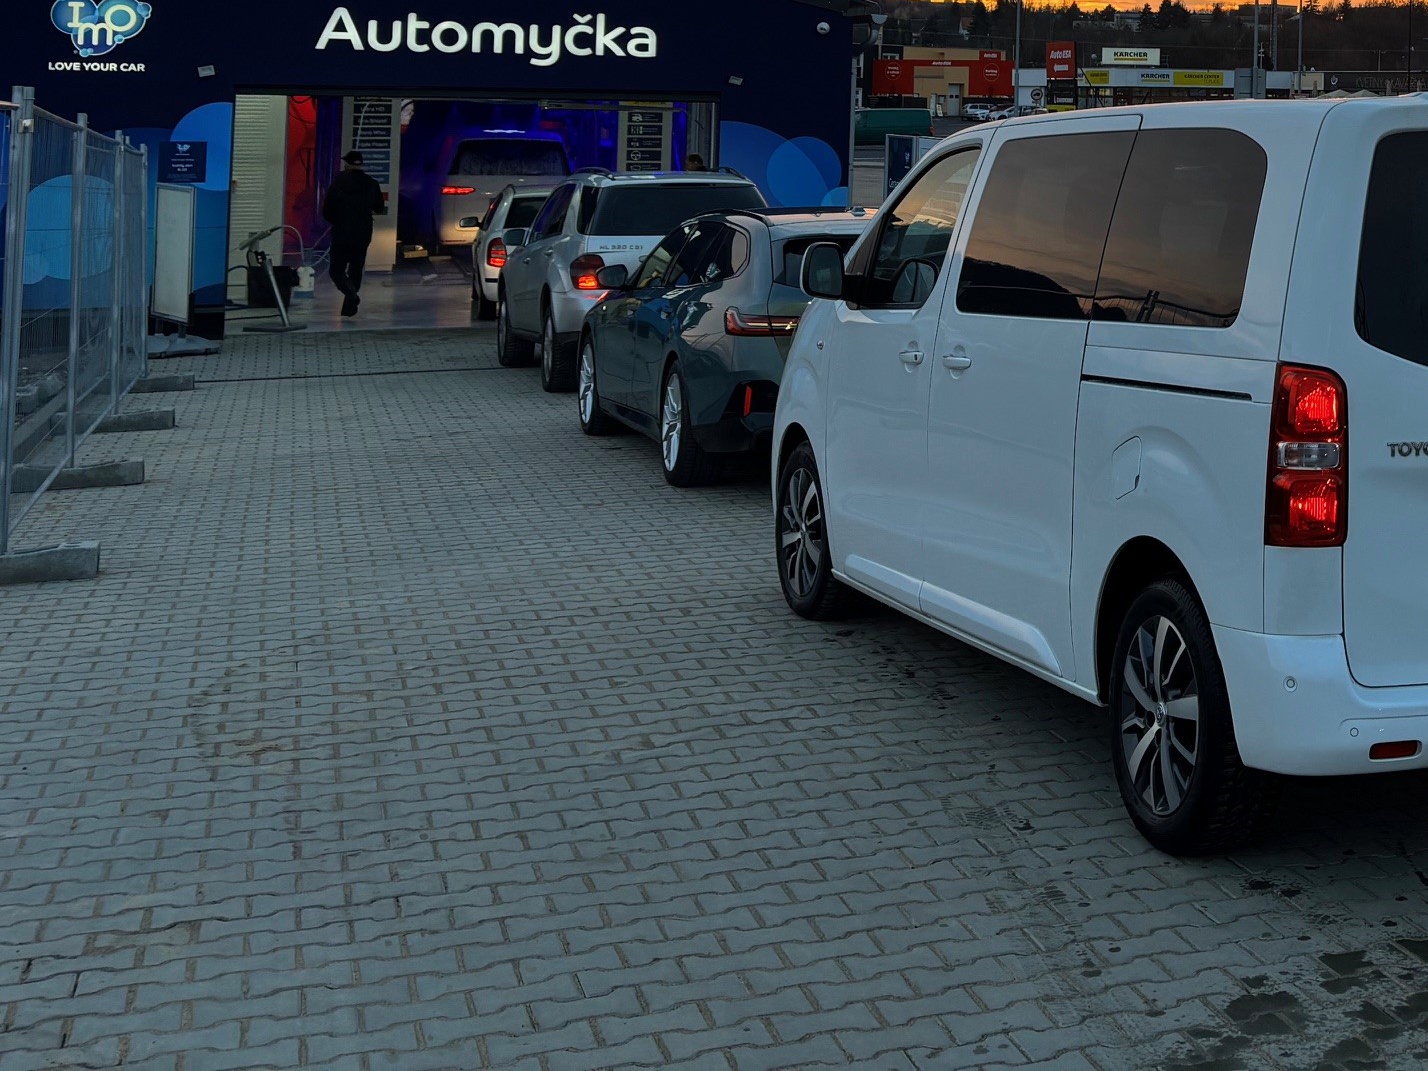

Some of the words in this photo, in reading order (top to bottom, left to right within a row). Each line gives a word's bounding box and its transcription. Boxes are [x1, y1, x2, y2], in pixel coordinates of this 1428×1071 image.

[315, 6, 657, 67] Automyčka
[48, 61, 81, 71] LOVE
[82, 62, 118, 72] YOUR
[119, 62, 146, 72] CAR
